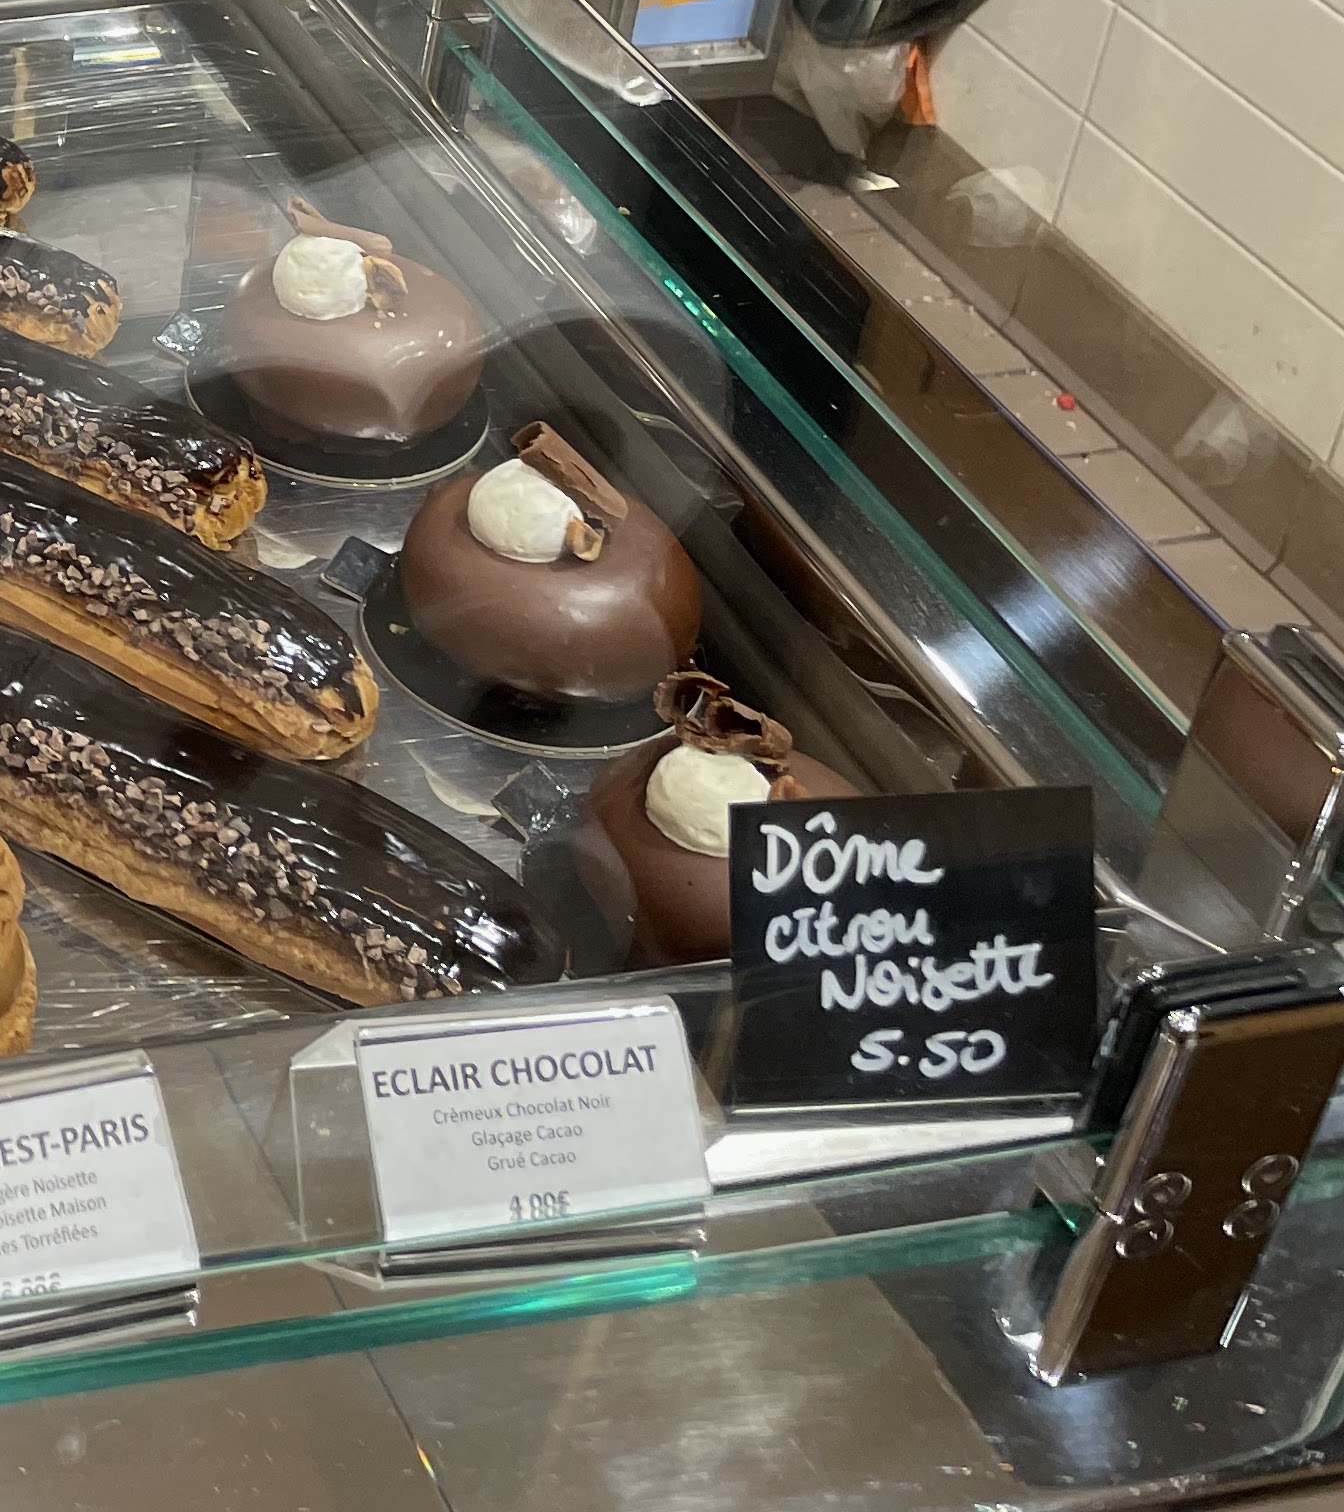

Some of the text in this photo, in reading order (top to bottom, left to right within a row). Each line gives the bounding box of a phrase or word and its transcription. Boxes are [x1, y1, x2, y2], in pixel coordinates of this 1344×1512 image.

[753, 812, 945, 894] Dôme
[850, 1029, 1007, 1078] 5.50
[373, 1044, 658, 1098] ECLAIR CHOCOLAT
[506, 1097, 574, 1118] Chocolat
[578, 1095, 611, 1110] Noir
[471, 1124, 583, 1148] Glaçage Cacao
[487, 1151, 577, 1171] Grué Cacao
[33, 1171, 98, 1194] Noisette
[50, 1195, 108, 1218] Maison
